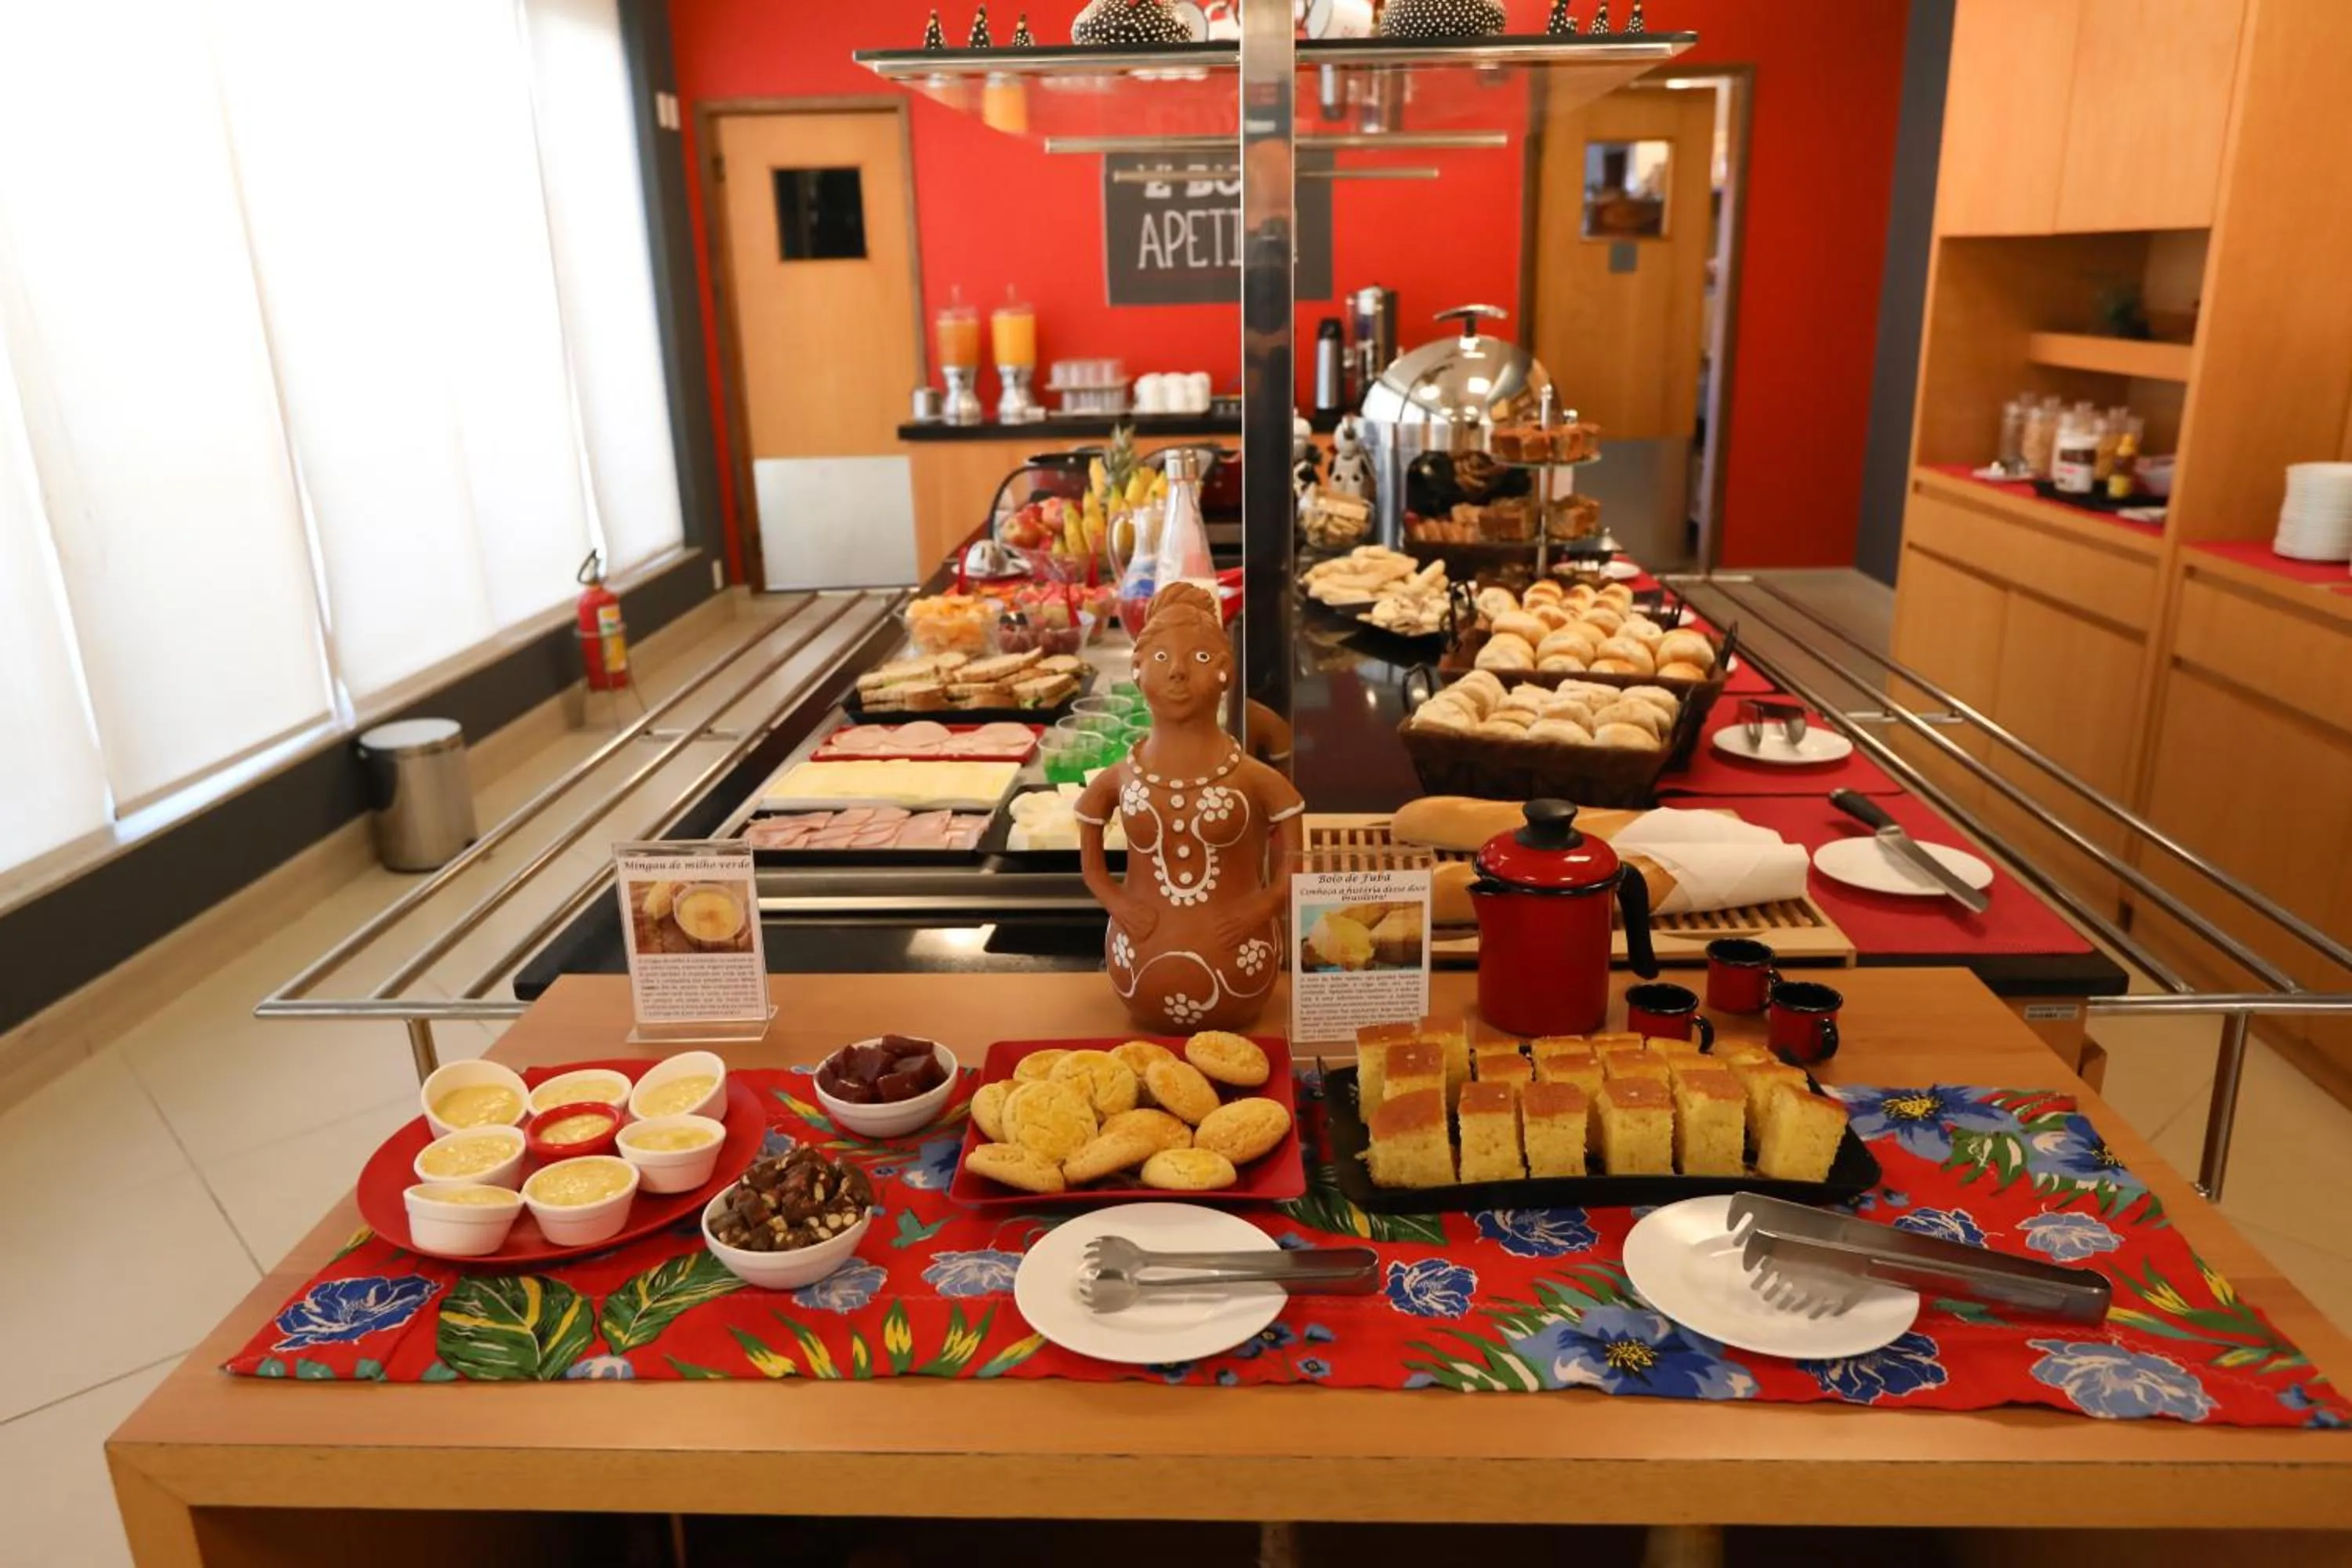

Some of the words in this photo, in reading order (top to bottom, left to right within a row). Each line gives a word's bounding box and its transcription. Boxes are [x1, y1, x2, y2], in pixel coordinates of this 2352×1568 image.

[625, 860, 666, 872] Mingau
[669, 860, 681, 869] de
[684, 860, 716, 869] milho
[718, 858, 750, 869] verde
[1318, 874, 1342, 884] Bolo
[1345, 873, 1357, 883] de
